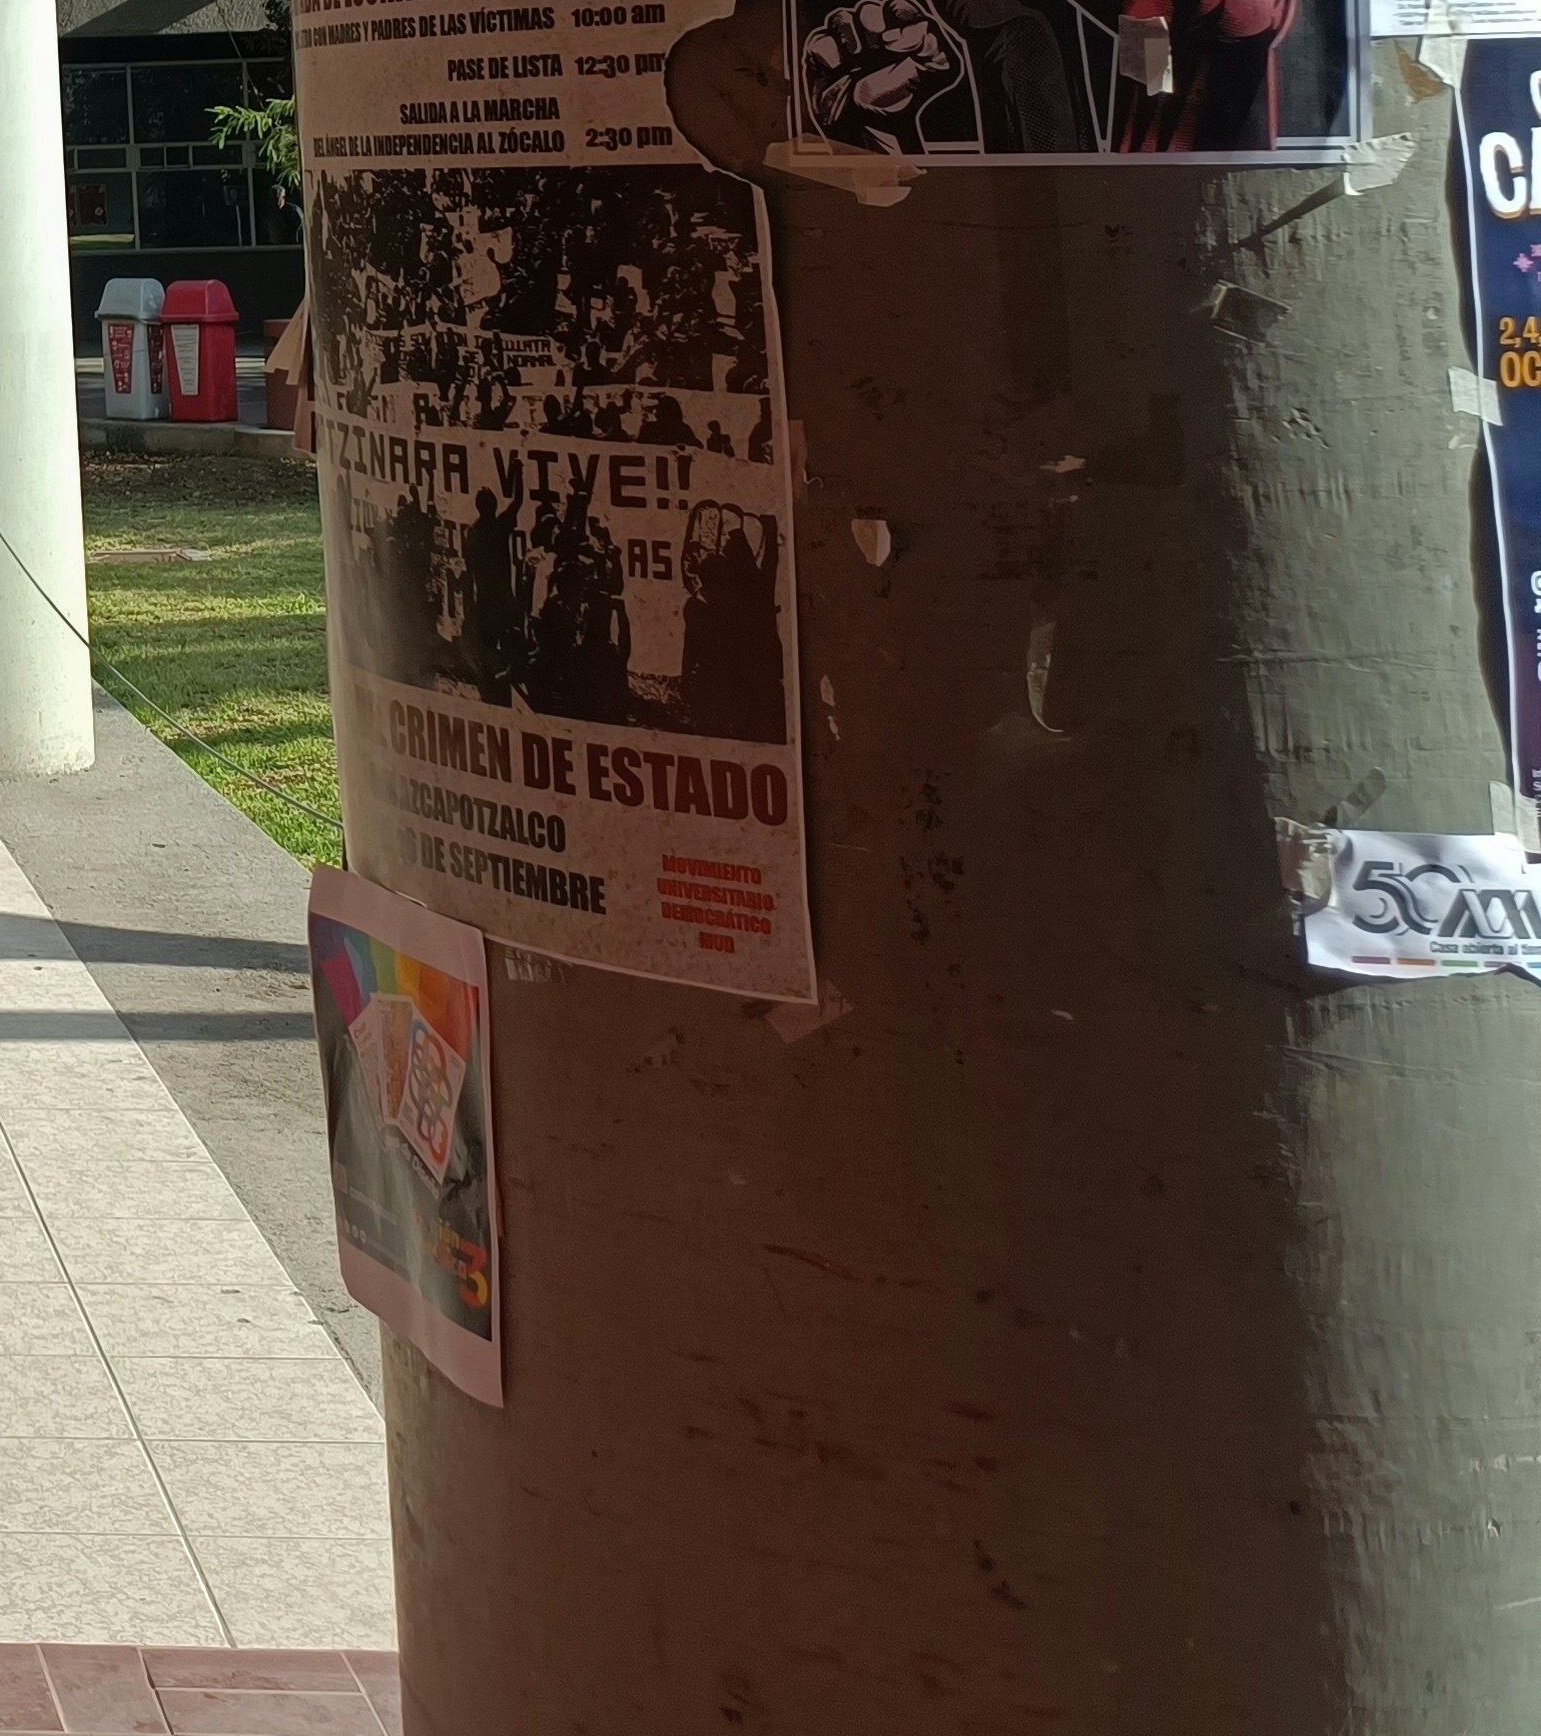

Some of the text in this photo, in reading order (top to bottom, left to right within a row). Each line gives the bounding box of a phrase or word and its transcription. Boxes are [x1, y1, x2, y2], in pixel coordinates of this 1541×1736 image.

[363, 22, 369, 41] Y
[371, 17, 416, 41] PADRES
[420, 15, 437, 37] DE
[440, 13, 466, 36] LAS
[469, 6, 555, 34] VÍCTIMAS
[571, 5, 627, 27] 10:00
[631, 4, 665, 24] am
[447, 58, 485, 81] PASE
[487, 57, 510, 80] DE
[512, 54, 563, 78] LISTA
[575, 54, 631, 78] 12:30
[400, 97, 560, 125] SALIDA A LA MARCHA
[360, 135, 372, 156] LA
[374, 133, 474, 156] INDEPENDENCIA
[477, 132, 496, 154] AL
[499, 127, 565, 154] ZÓCALO
[586, 125, 633, 150] 2:30
[636, 126, 673, 147] pm
[493, 448, 691, 510] VIVE!!
[390, 700, 511, 784] CRIMEN
[522, 731, 576, 795] DE
[587, 745, 788, 826] ESTADO
[420, 834, 446, 873] DE
[449, 841, 607, 914] SEPTIEMBRE
[662, 854, 762, 885] MOVIMIENTO
[657, 877, 774, 911] UNIVERSITARIO
